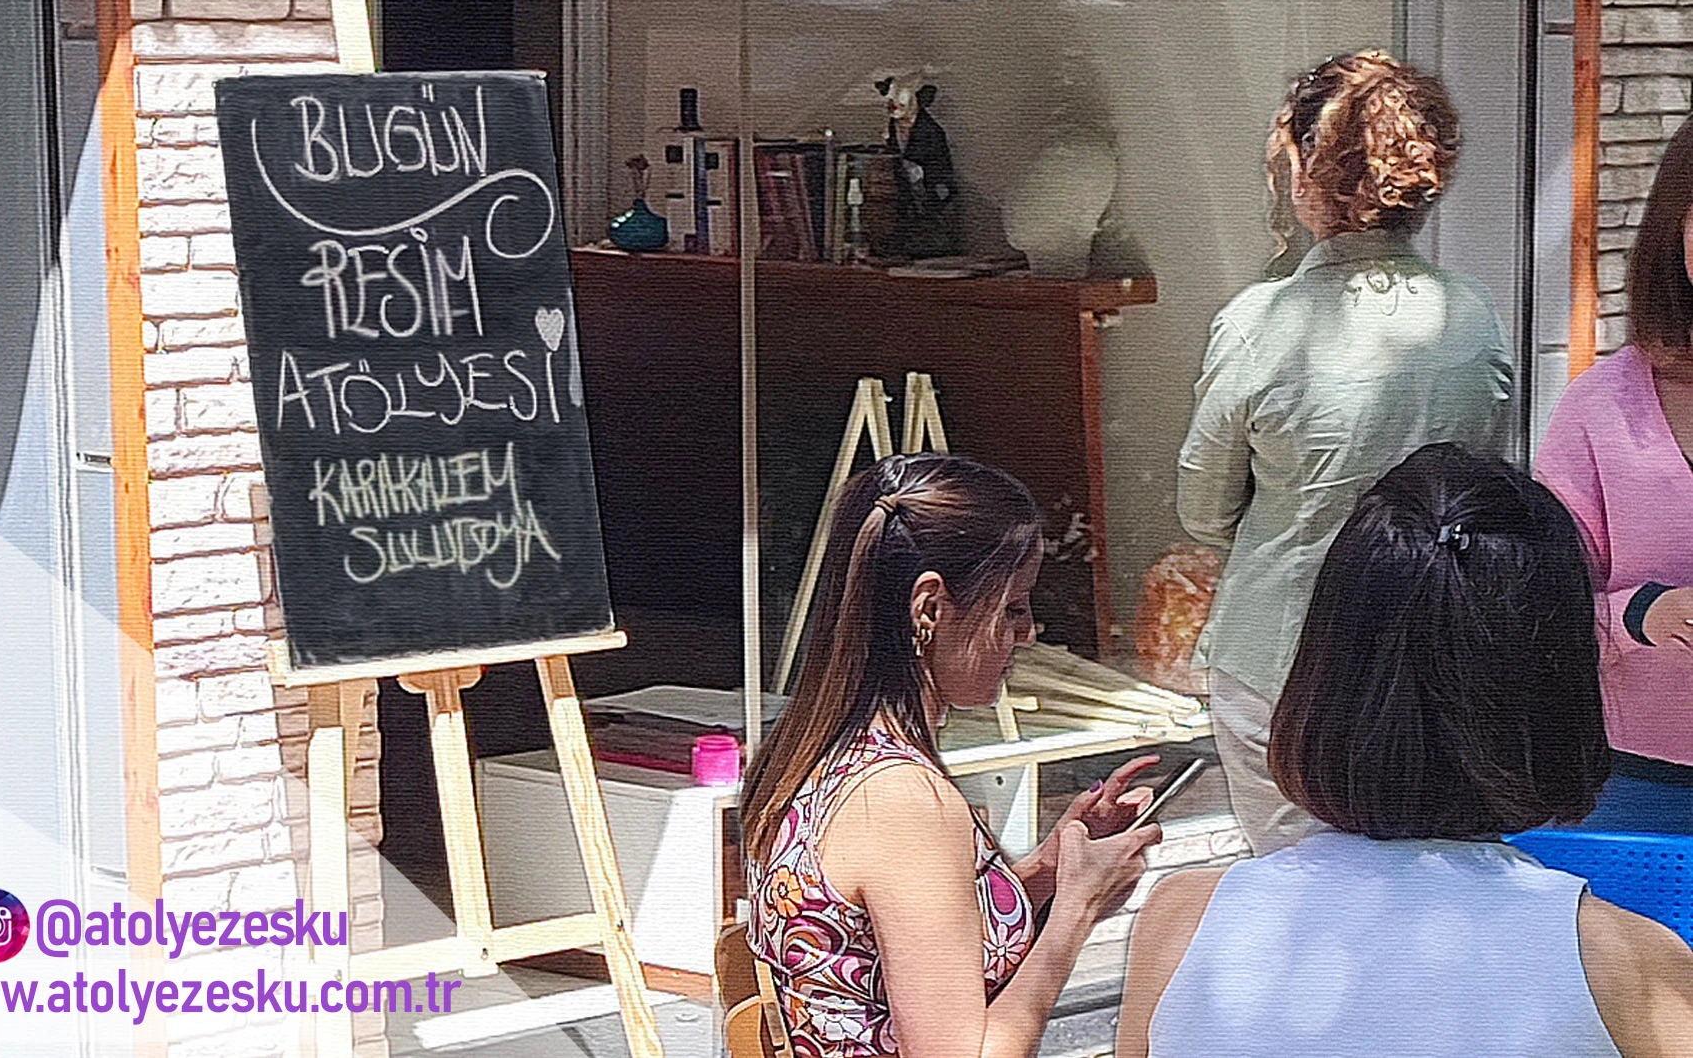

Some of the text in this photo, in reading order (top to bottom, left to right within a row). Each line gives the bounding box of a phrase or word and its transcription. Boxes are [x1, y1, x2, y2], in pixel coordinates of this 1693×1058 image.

[290, 84, 488, 182] BUGÜN
[302, 227, 484, 338] RESİM
[309, 442, 523, 526] KARAKALEM
[344, 500, 562, 589] SULUBOYA
